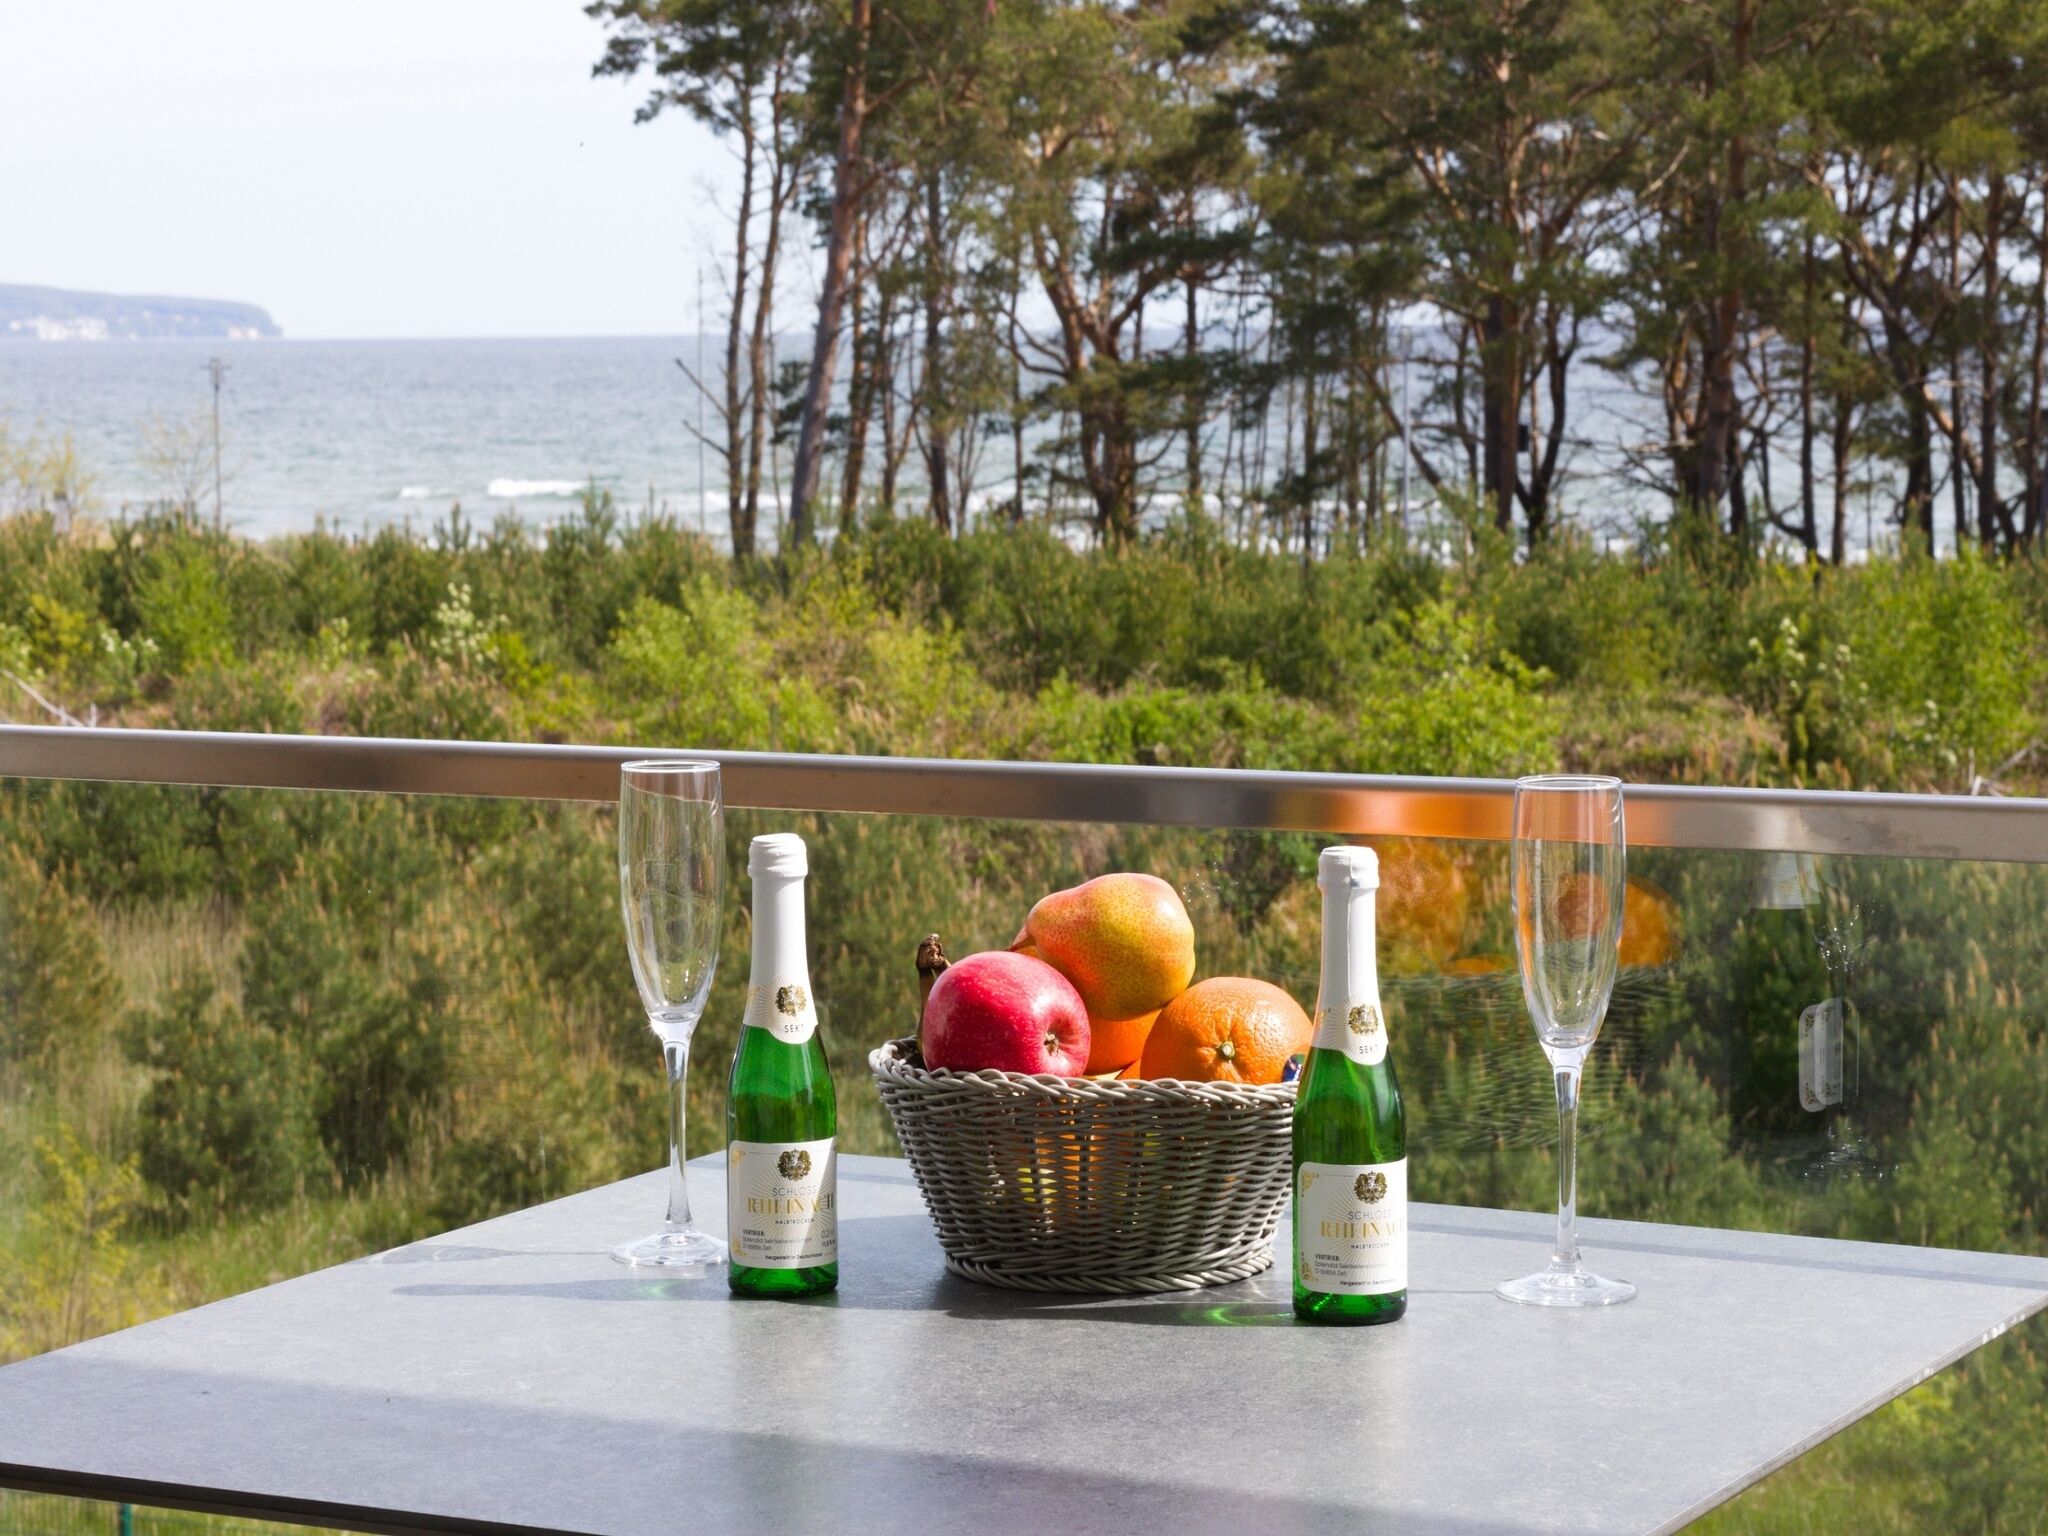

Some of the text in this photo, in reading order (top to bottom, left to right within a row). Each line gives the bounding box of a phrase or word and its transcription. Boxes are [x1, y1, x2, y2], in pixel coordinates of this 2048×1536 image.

[784, 1024, 804, 1033] SEKT
[772, 1185, 817, 1197] SCHLOSS
[1348, 1208, 1392, 1220] SCHLOSS
